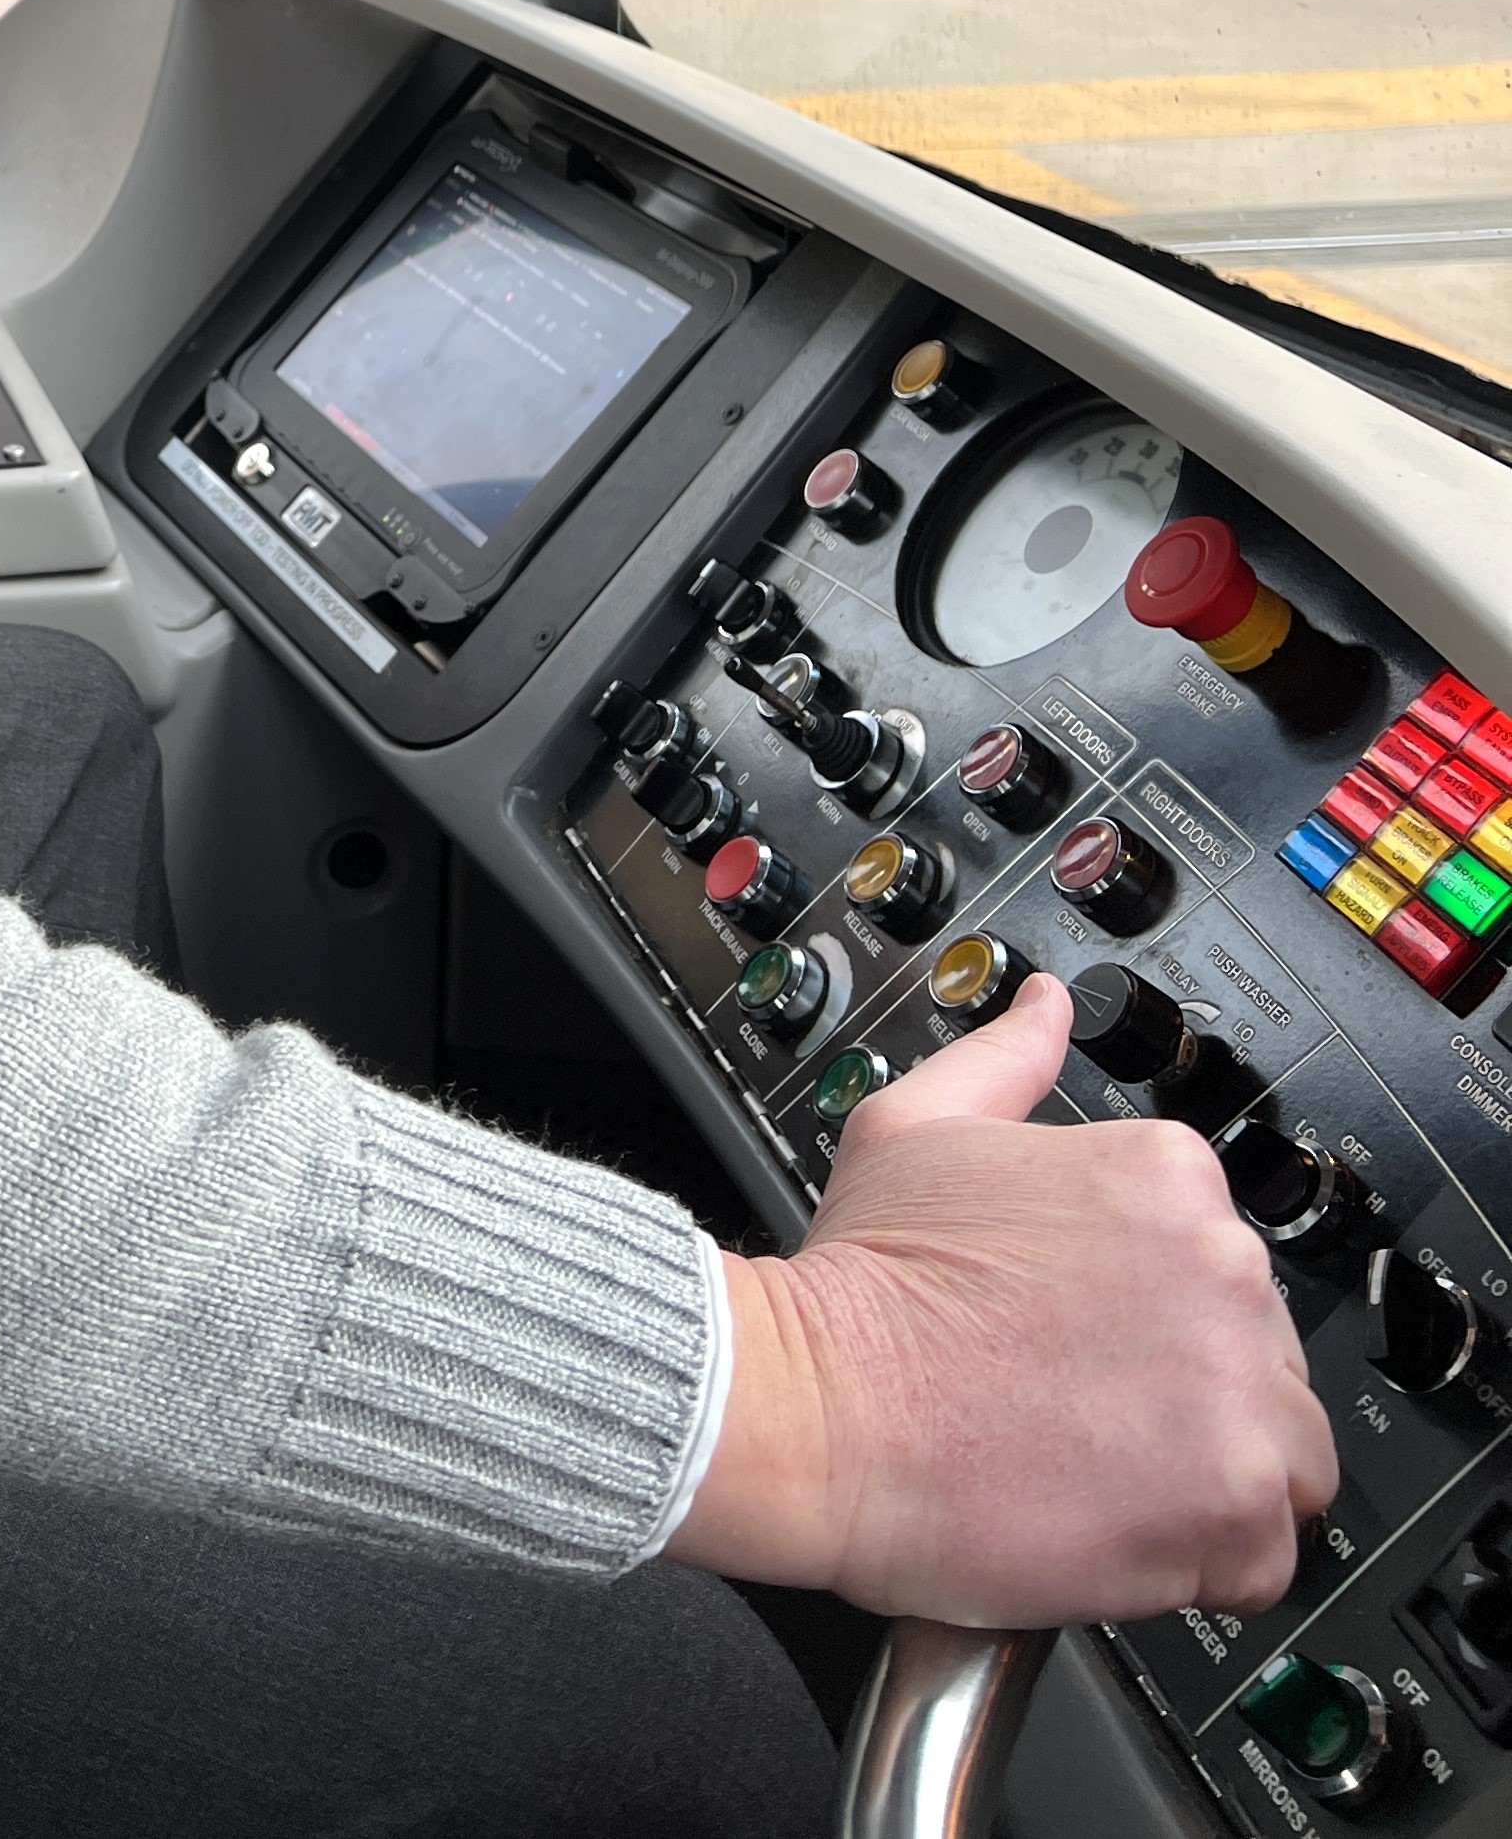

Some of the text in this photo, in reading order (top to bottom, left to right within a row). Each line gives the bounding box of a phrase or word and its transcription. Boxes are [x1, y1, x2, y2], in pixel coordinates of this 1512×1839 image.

[313, 588, 366, 642] PROGRESS
[1177, 680, 1218, 719] BRAKE
[1178, 655, 1245, 710] EMERGENCY
[1442, 688, 1472, 711] PASS
[689, 694, 708, 712] OFF
[697, 727, 712, 744] ON
[763, 732, 784, 756] BELL
[1041, 696, 1116, 765] LEFT DOORS
[613, 759, 631, 785] CAB
[1444, 774, 1485, 805] BYPASS
[817, 795, 844, 825] HORN
[1140, 784, 1232, 869] RIGHT DOORS
[962, 812, 991, 843] OPEN
[1391, 827, 1432, 861] BRAKES
[662, 846, 683, 875] TURN
[1392, 851, 1409, 866] ON
[1437, 874, 1484, 916] RELEASE
[1452, 862, 1496, 900] BRAKES
[1336, 891, 1374, 925] HAZARD
[698, 898, 749, 965] TRACK BRAKE
[843, 910, 884, 958] RELEASE
[1056, 910, 1088, 942] OPEN
[1160, 955, 1200, 995] DELAY
[1207, 943, 1293, 1030] PUSH WASHER
[739, 1022, 769, 1060] CLOSE
[1232, 1019, 1255, 1043] LO
[1232, 1045, 1250, 1065] HI
[1450, 1034, 1512, 1100] CONSOLE
[1457, 1074, 1512, 1133] DIMMER
[815, 1132, 837, 1165] CLO
[1339, 1134, 1373, 1163] OFF
[1364, 1191, 1387, 1214] HI
[1417, 1247, 1453, 1278] OFF
[1481, 1269, 1508, 1297] LO
[1355, 1394, 1391, 1434] FAN
[1327, 1528, 1356, 1560] ON
[1178, 1607, 1228, 1665] GGER
[1392, 1668, 1431, 1706] OFF
[1422, 1748, 1454, 1785] ON
[1238, 1737, 1307, 1832] MIRRORS
